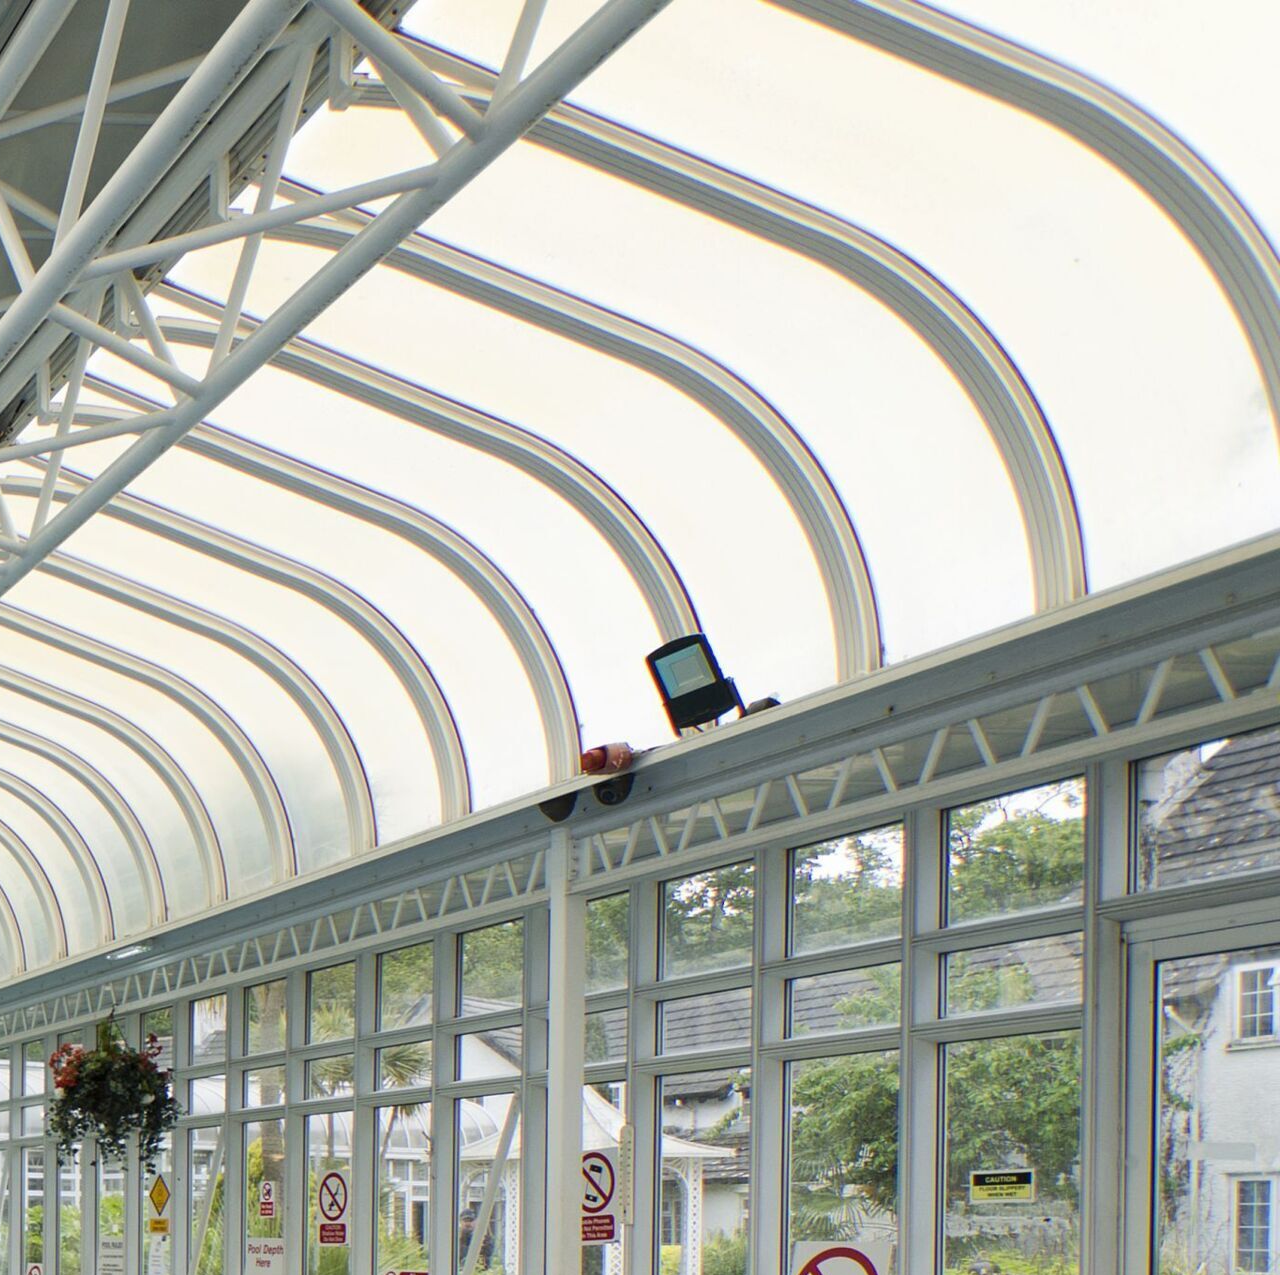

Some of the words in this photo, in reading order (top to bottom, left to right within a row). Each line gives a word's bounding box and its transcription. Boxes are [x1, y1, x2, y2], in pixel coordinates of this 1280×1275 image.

[984, 1175, 1017, 1184] CAUTION
[247, 1243, 262, 1255] Pool
[263, 1243, 284, 1256] Depth
[255, 1258, 271, 1268] Here
